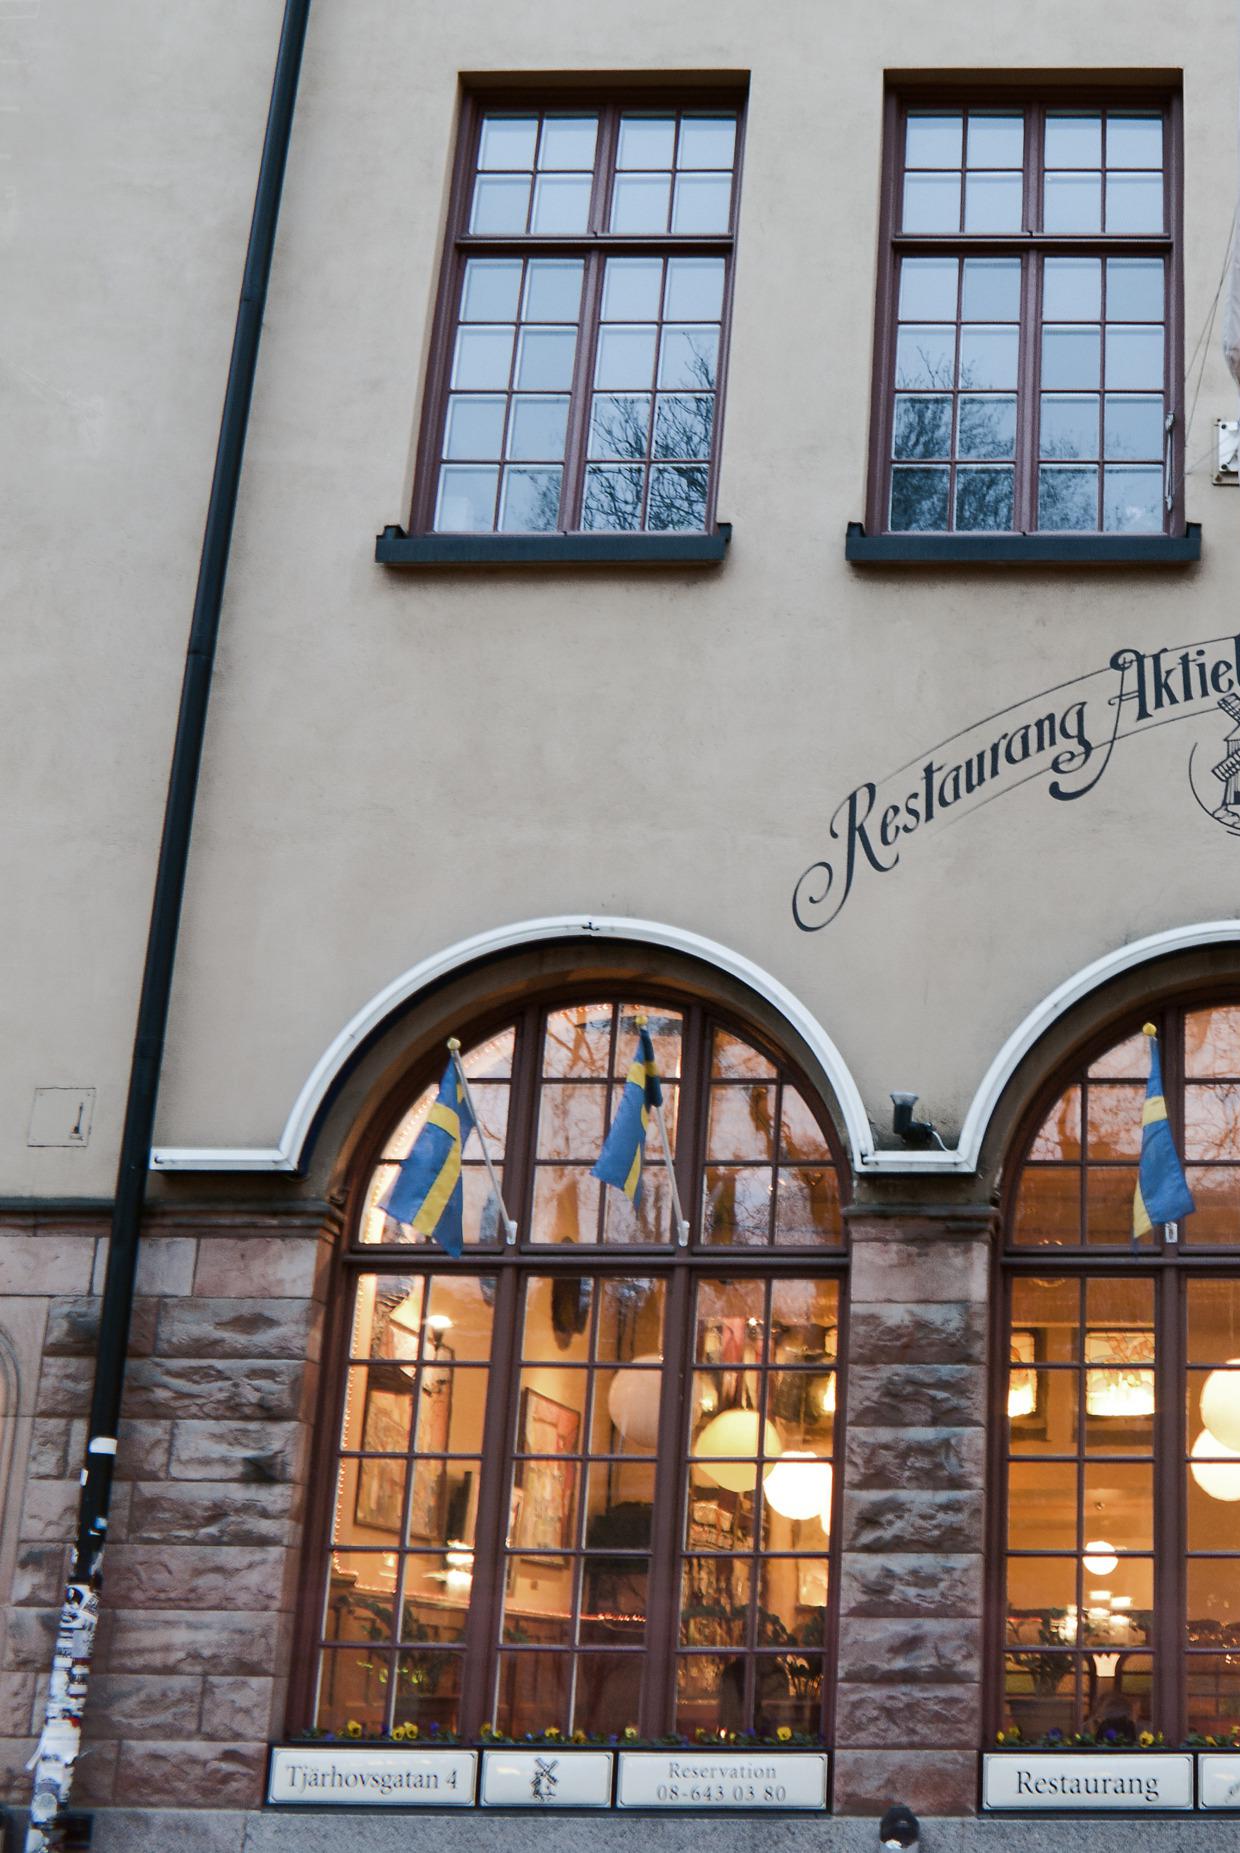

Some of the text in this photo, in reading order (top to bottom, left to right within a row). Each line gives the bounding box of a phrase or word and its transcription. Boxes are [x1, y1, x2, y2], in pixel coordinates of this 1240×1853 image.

[792, 700, 1094, 932] Restaurang
[286, 1764, 458, 1795] Tjärhovsgatan 4
[668, 1762, 777, 1779] Reservation
[1016, 1770, 1160, 1802] Restaurang
[656, 1784, 787, 1802] 08-643 03 80
